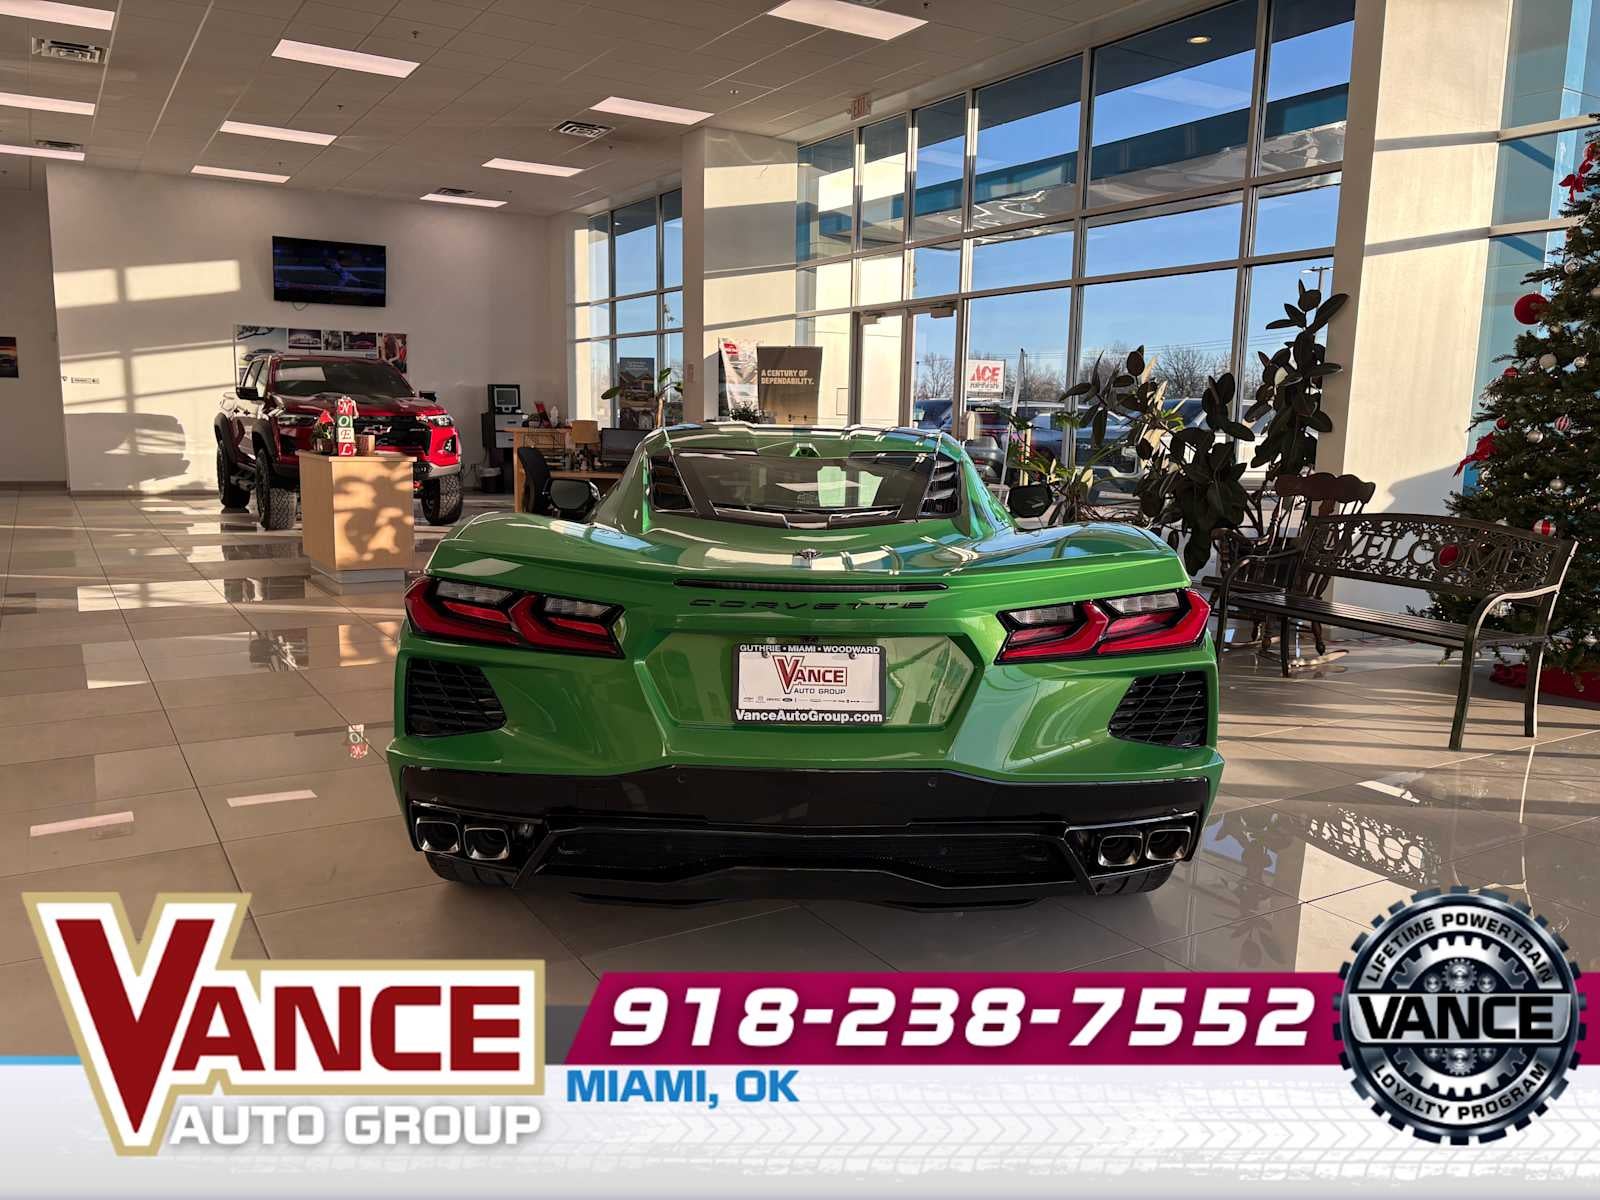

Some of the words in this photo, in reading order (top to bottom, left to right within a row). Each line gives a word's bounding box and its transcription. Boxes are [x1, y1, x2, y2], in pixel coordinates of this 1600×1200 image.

[767, 369, 798, 377] CENTURY
[798, 369, 808, 377] OF
[969, 364, 1001, 382] ACE
[760, 377, 815, 385] DEPENDABILITY.
[1322, 522, 1540, 578] WELCOME
[689, 599, 929, 611] CORVETTE
[739, 644, 781, 652] GUTHRIE
[787, 645, 817, 653] MIAMI
[822, 645, 880, 653] WOODWARD
[775, 657, 845, 691] VANCE
[735, 709, 883, 723] VanceAutoGroup.com
